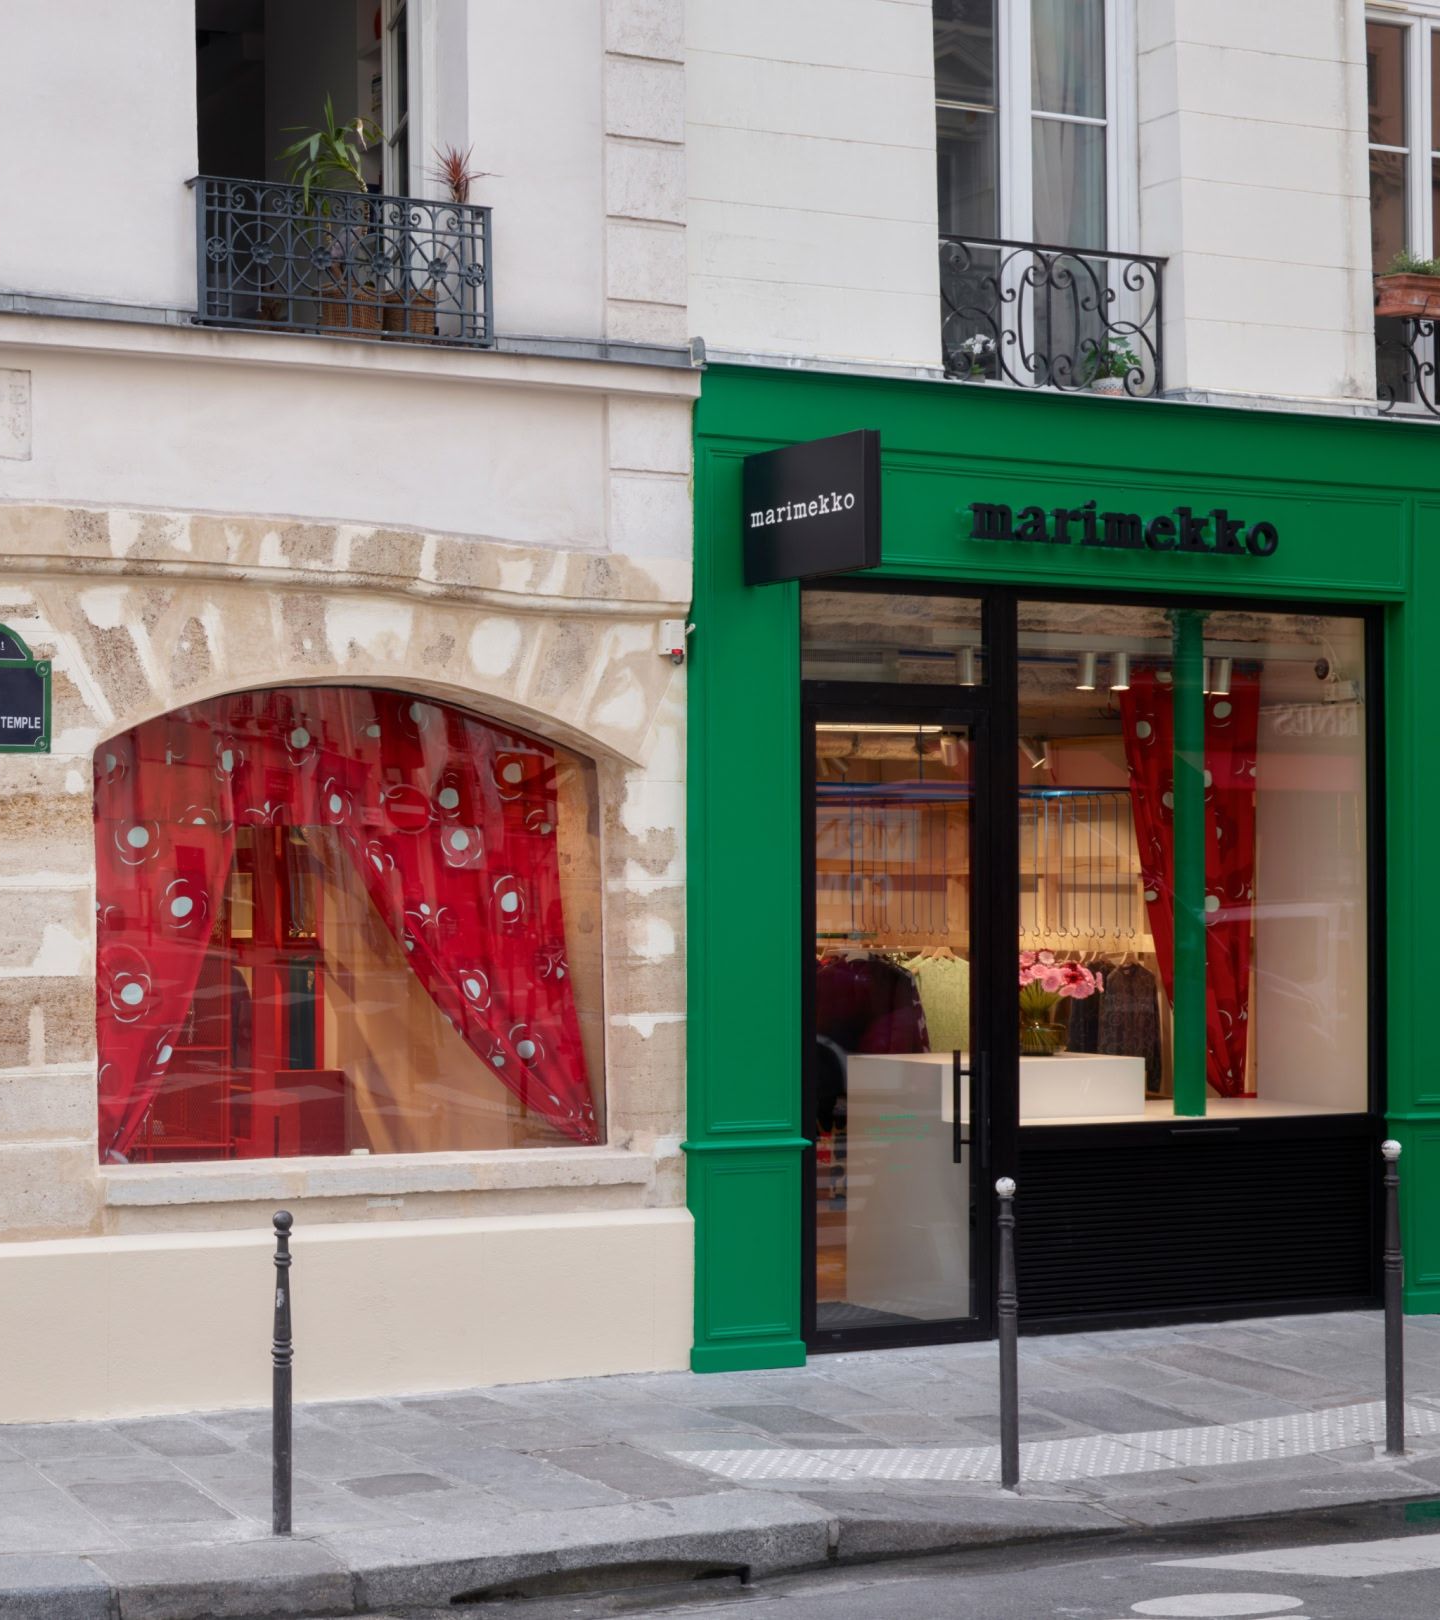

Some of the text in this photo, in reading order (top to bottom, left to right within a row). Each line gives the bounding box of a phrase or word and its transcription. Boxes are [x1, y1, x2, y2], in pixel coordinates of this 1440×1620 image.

[750, 491, 855, 528] marimekko
[968, 500, 1279, 557] marimekko
[0, 716, 41, 729] TEMPLE
